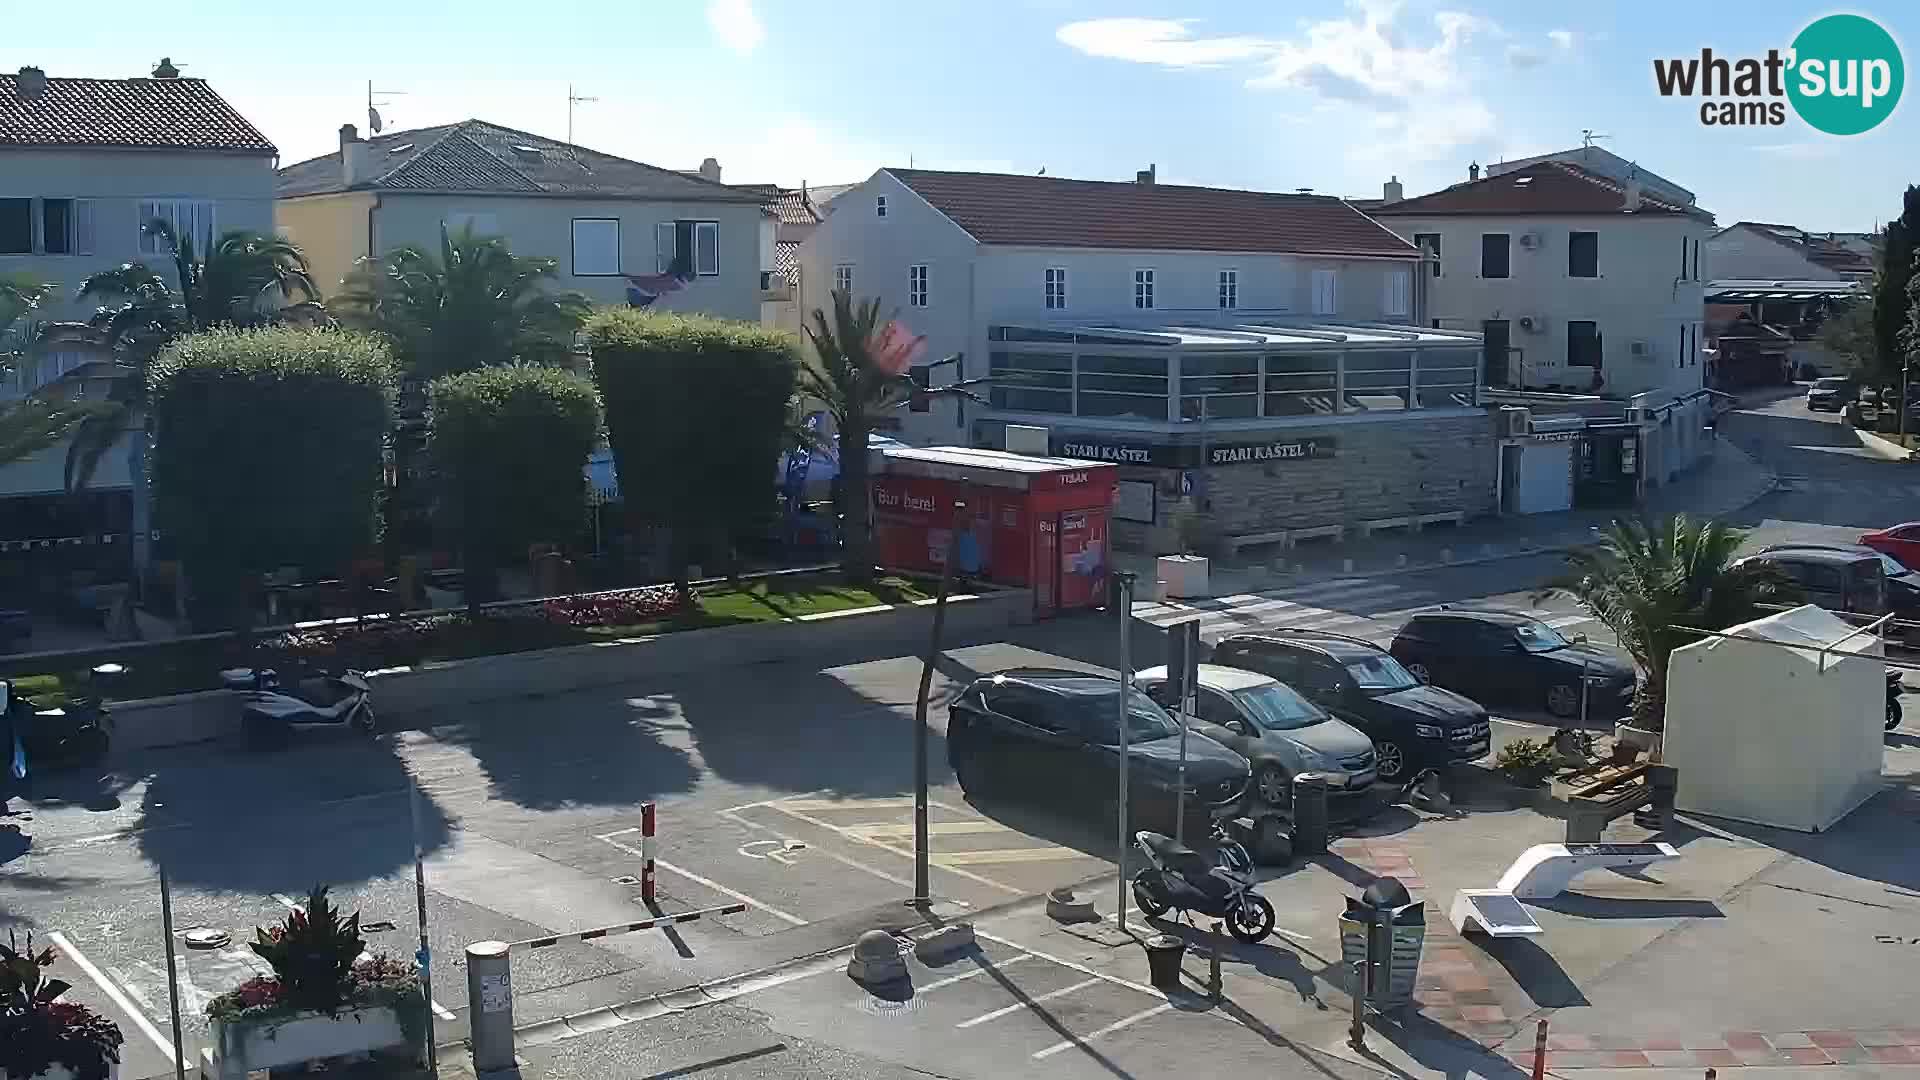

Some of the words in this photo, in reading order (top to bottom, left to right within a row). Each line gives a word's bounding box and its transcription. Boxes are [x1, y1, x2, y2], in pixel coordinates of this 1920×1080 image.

[1063, 444, 1099, 458] STARI
[1102, 445, 1151, 462] KAŠTEL
[1213, 447, 1251, 462] STARI
[1255, 442, 1304, 459] KAŠTEL
[1039, 520, 1056, 533] Buy
